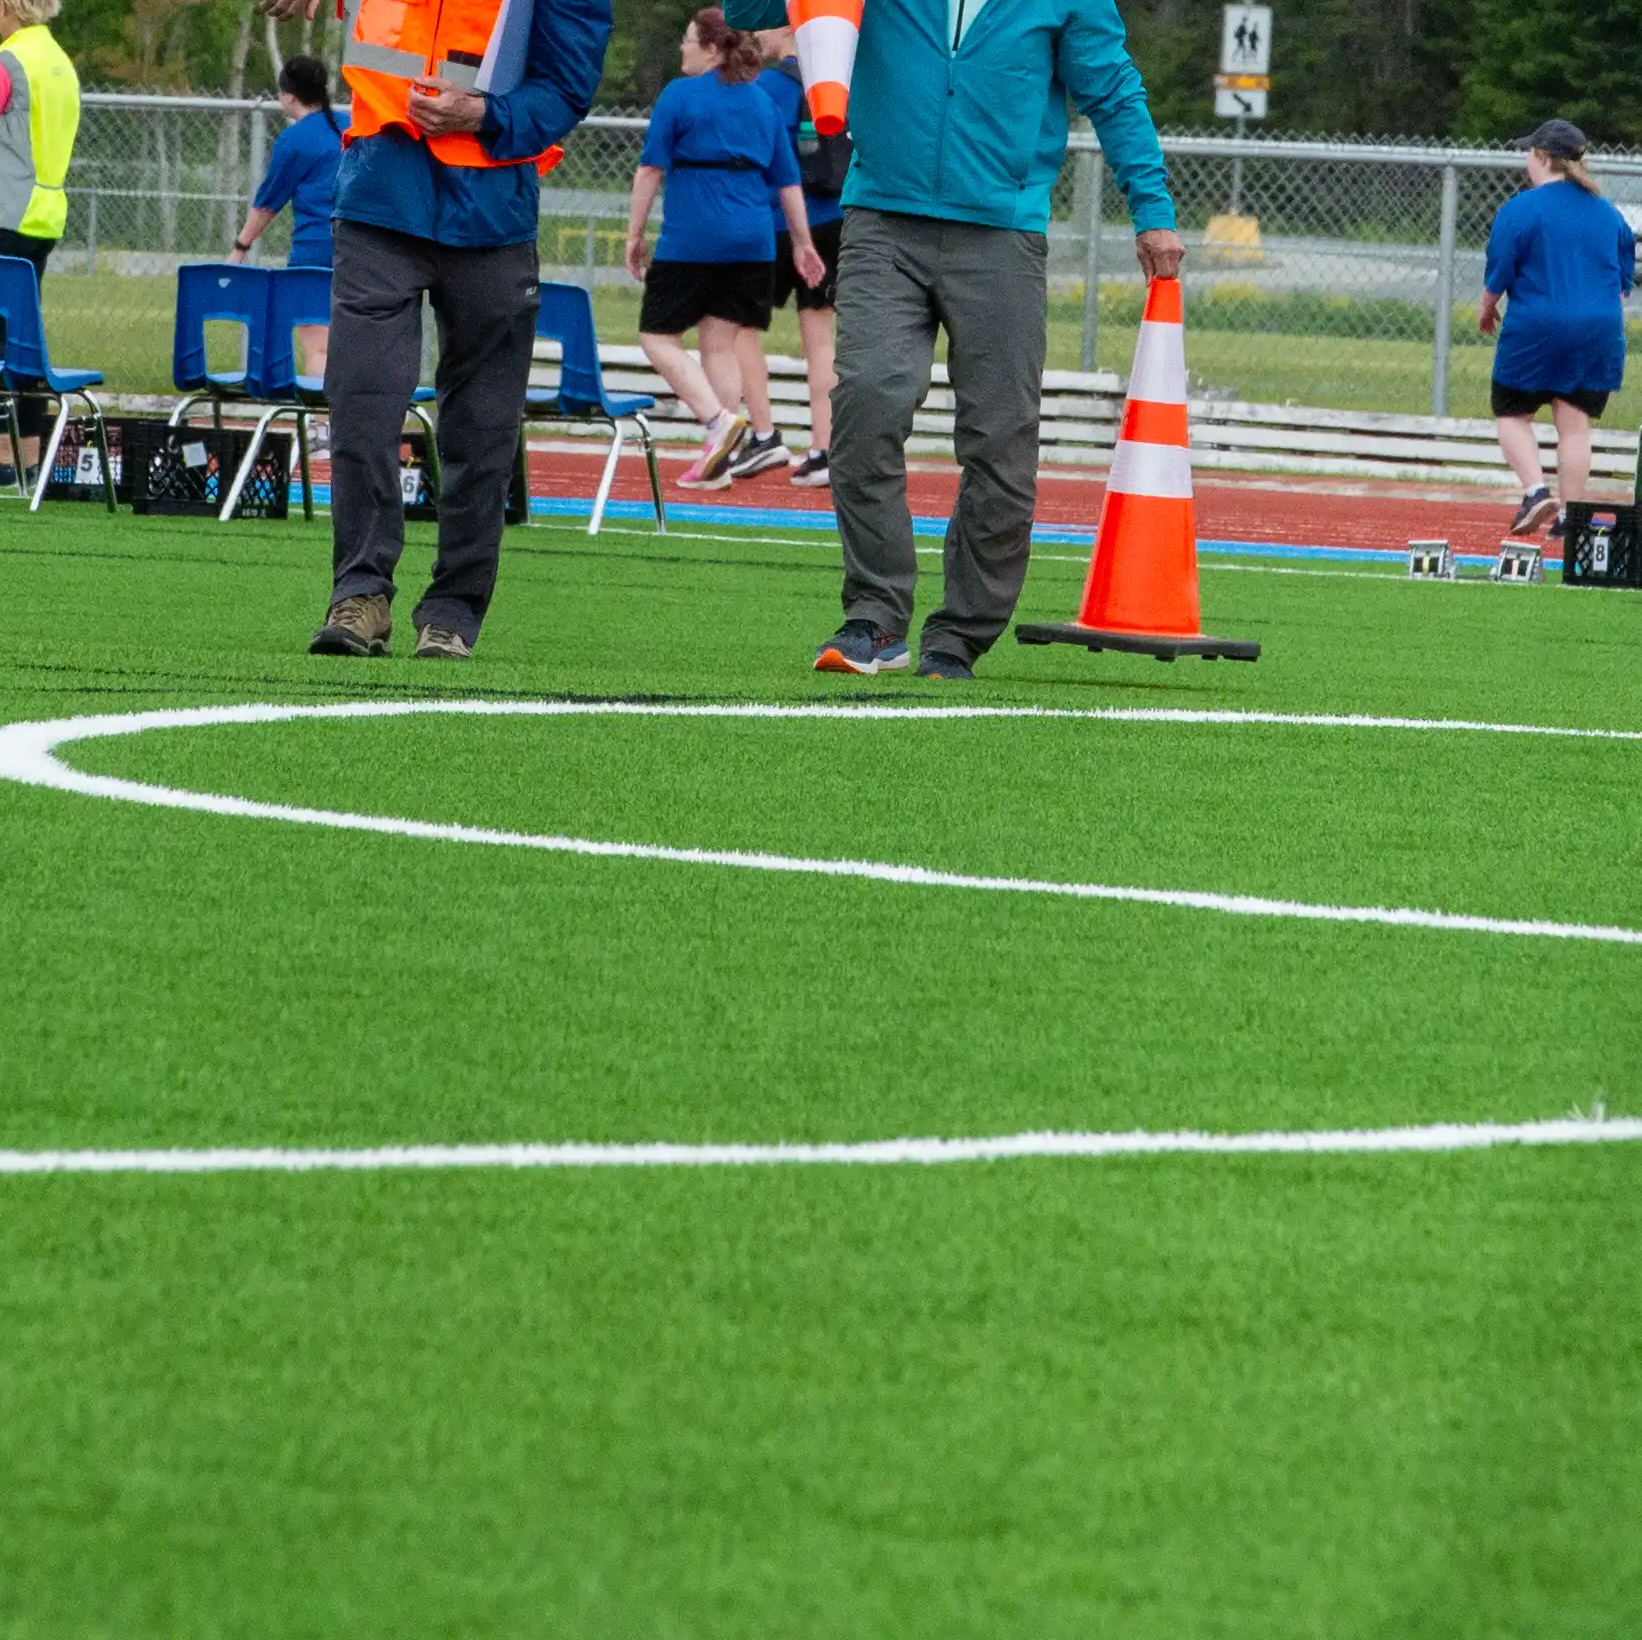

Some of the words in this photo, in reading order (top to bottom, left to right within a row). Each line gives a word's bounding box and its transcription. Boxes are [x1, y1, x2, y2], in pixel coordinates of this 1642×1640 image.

[80, 454, 94, 472] 5
[403, 475, 415, 494] 6
[1595, 544, 1605, 562] 8
